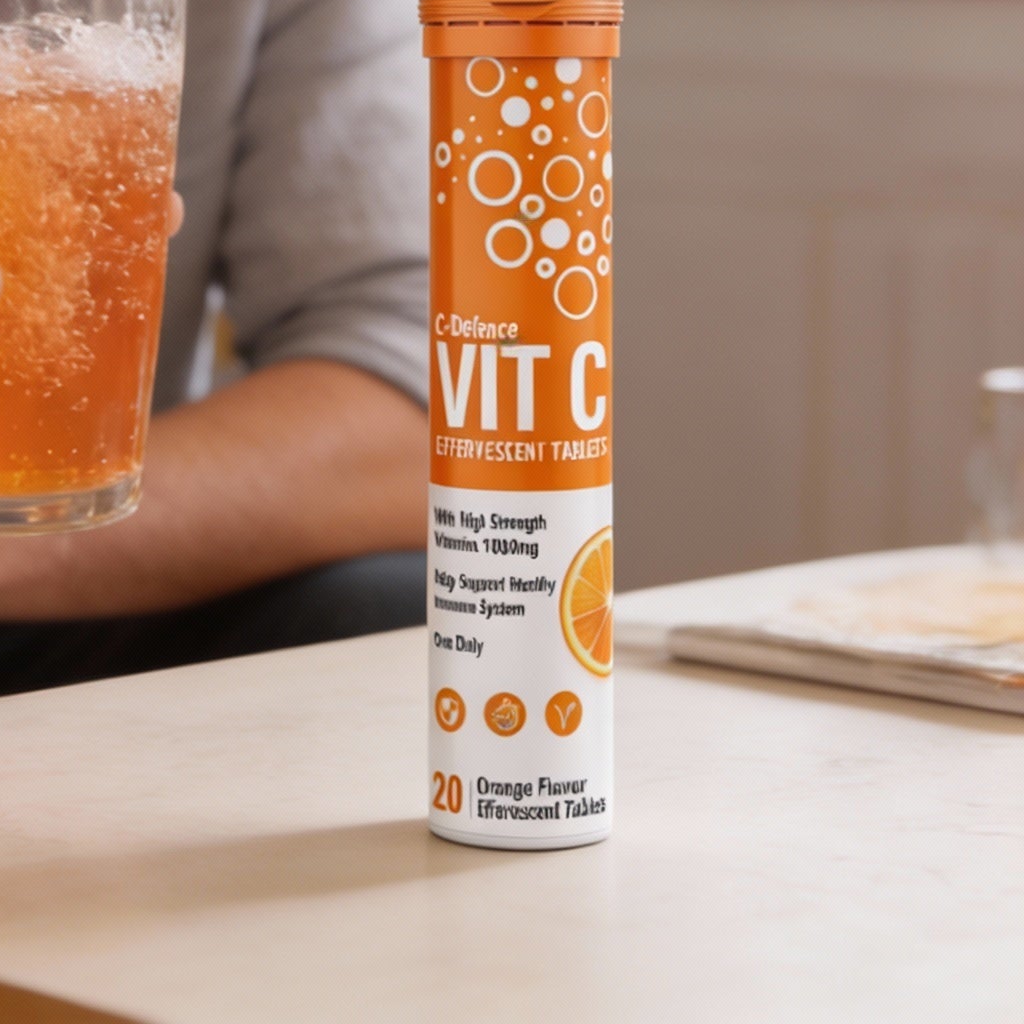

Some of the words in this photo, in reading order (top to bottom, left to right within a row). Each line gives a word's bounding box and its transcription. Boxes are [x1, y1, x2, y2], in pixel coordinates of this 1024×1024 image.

[436, 340, 552, 432] VIT
[570, 340, 607, 432] C
[435, 435, 546, 462] EFFERVESCENT
[550, 436, 609, 461] TABLETS
[432, 770, 464, 814] 20
[476, 776, 533, 801] Orange
